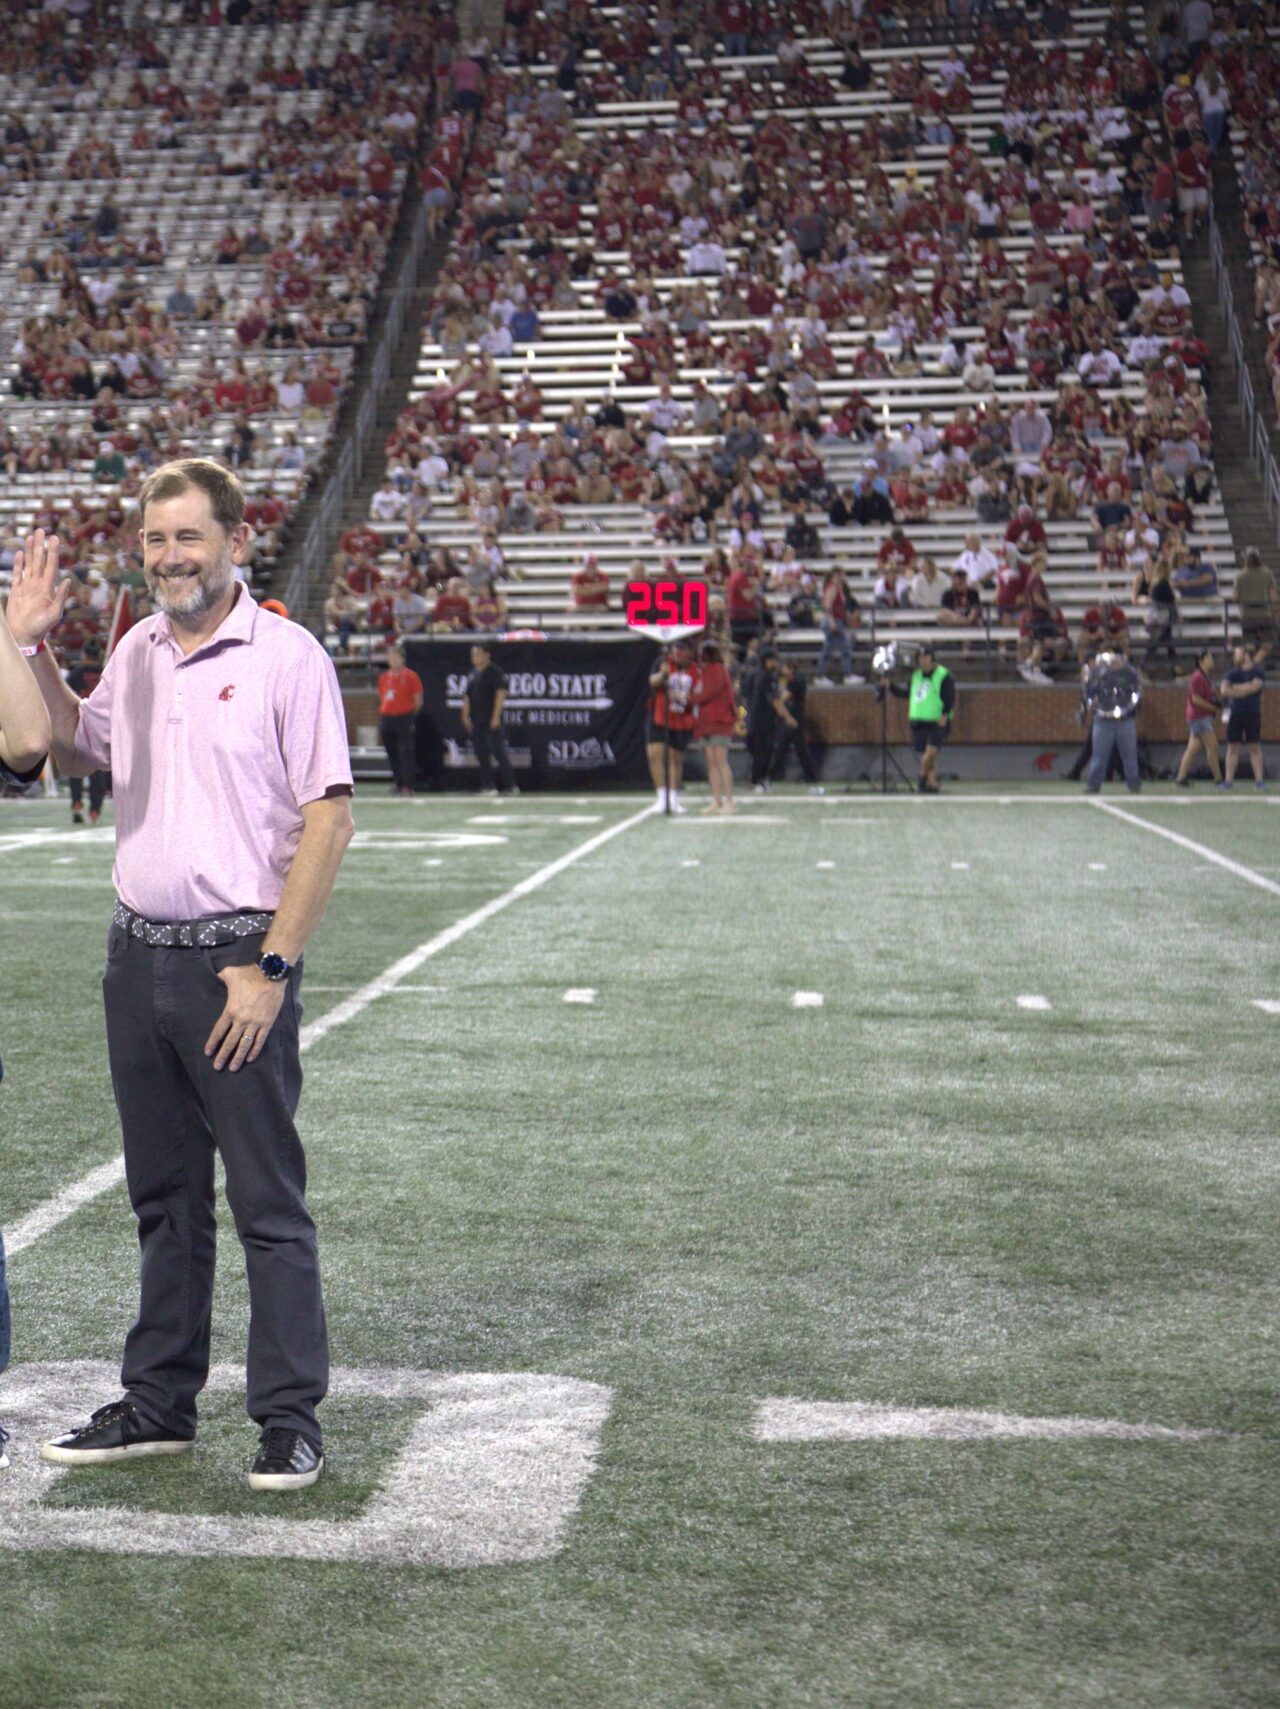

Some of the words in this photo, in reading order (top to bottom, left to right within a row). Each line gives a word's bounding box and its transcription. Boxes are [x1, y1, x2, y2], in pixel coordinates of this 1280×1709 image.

[627, 581, 707, 627] 250
[446, 674, 468, 695] SA
[548, 674, 607, 696] STATE
[528, 711, 591, 725] MEDICINE
